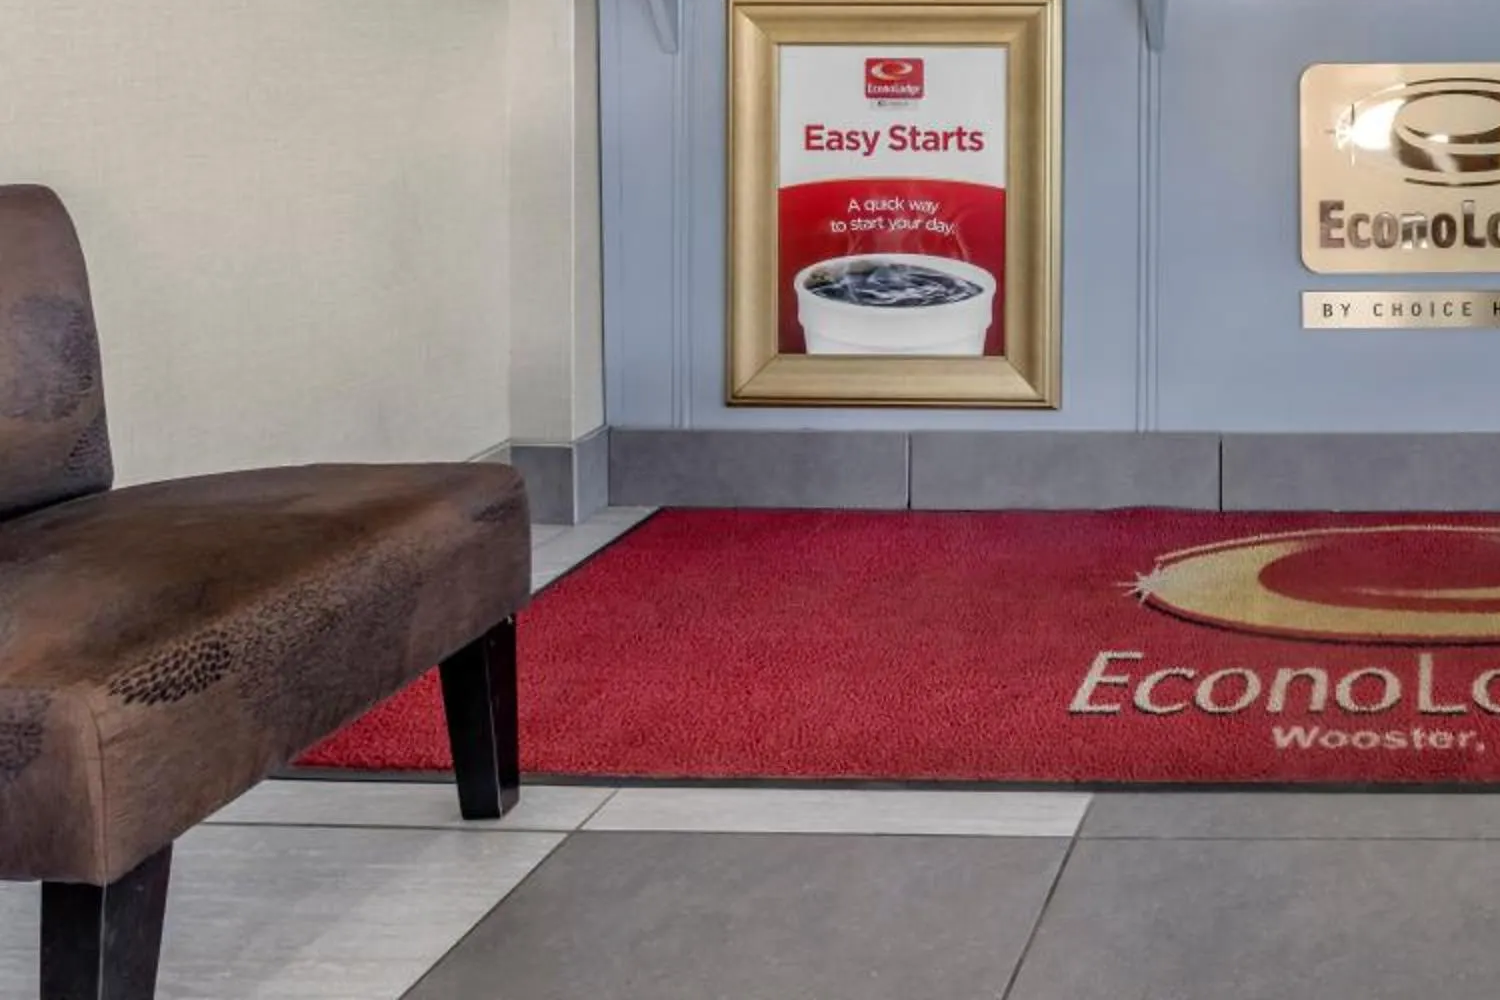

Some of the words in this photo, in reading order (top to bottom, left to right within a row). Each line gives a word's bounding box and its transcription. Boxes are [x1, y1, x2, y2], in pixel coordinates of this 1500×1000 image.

[804, 125, 880, 156] Easy
[888, 125, 984, 151] Starts
[848, 199, 860, 212] A
[864, 197, 904, 214] quick
[909, 200, 938, 213] way
[831, 220, 847, 233] to
[851, 216, 883, 230] start
[888, 217, 922, 231] your
[1322, 302, 1351, 318] BY
[1373, 302, 1473, 317] CHOICE
[1271, 724, 1485, 751] Wooster,
